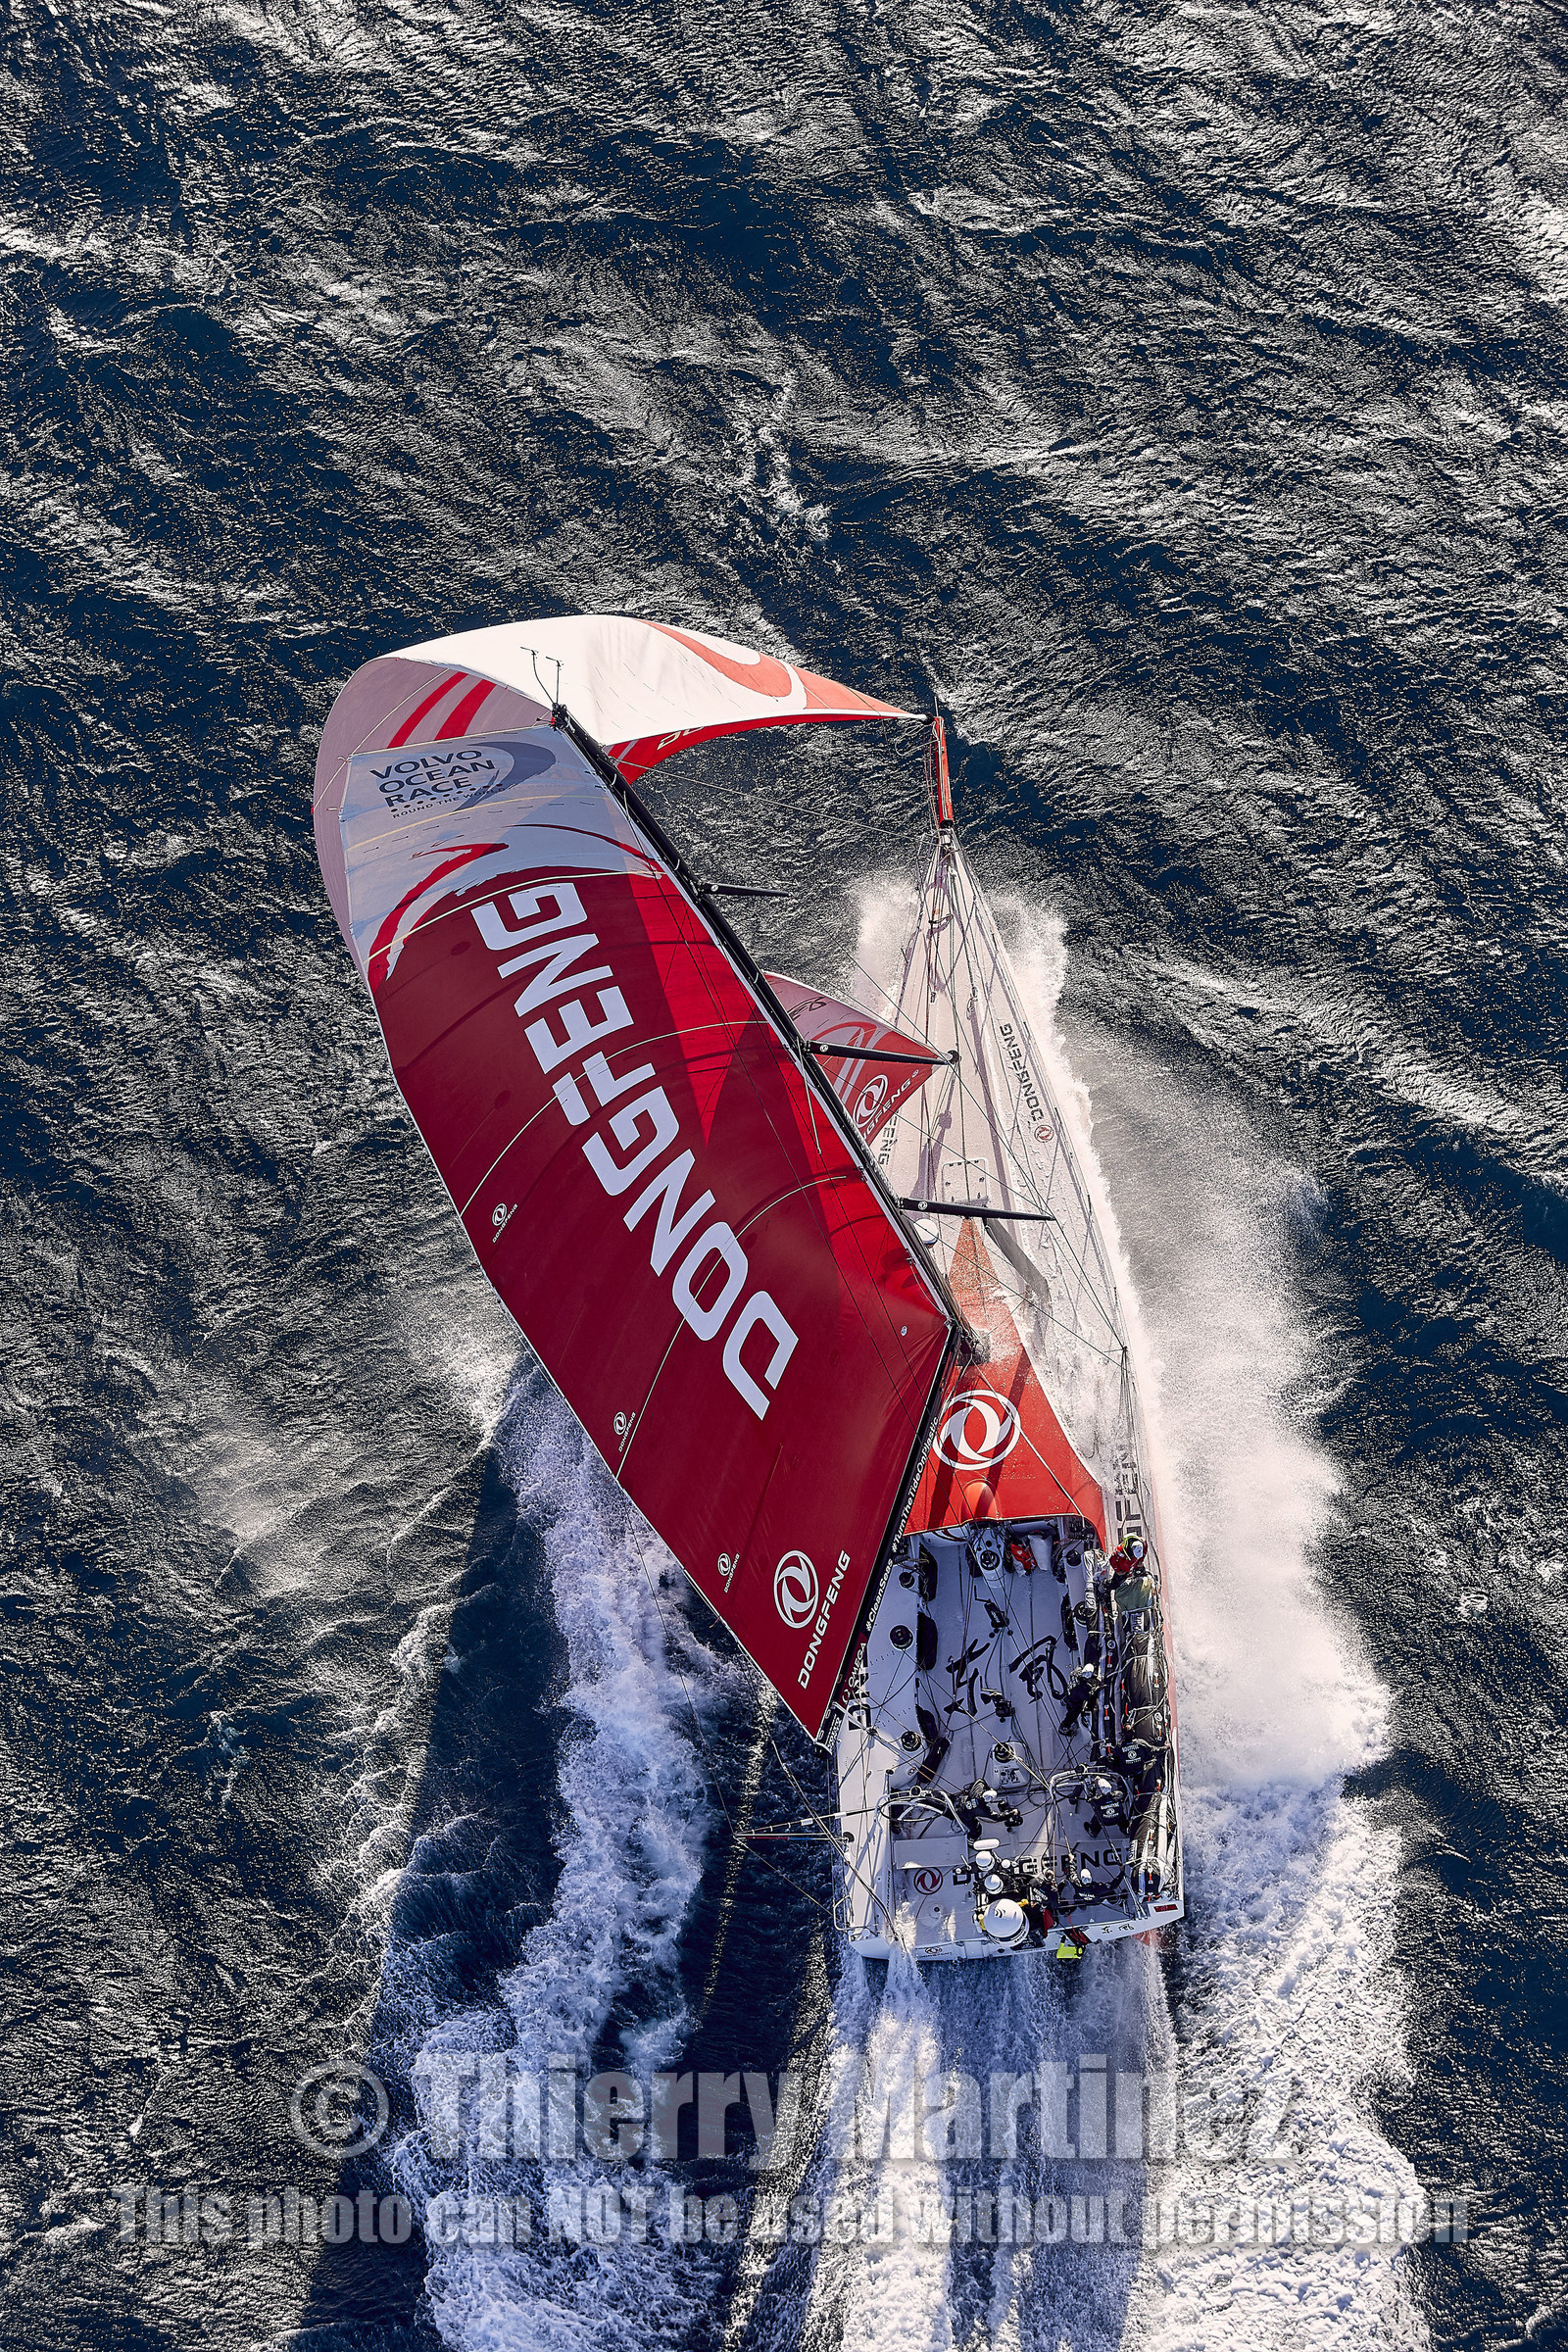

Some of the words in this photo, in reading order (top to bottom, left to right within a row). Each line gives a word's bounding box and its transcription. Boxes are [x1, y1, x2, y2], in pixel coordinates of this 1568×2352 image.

[369, 750, 482, 779] VOLVO
[378, 760, 495, 794] OCEAN
[384, 776, 472, 808] RACE
[392, 804, 433, 819] ROUND
[437, 797, 461, 806] THE
[464, 787, 506, 799] WORLD
[1000, 1022, 1045, 1122] DONGFENG
[470, 882, 799, 1421] DONGFENG
[865, 1558, 894, 1632] #CleanSeas
[797, 1549, 852, 1690] DONGFENG
[848, 1642, 867, 1688] OMEGA
